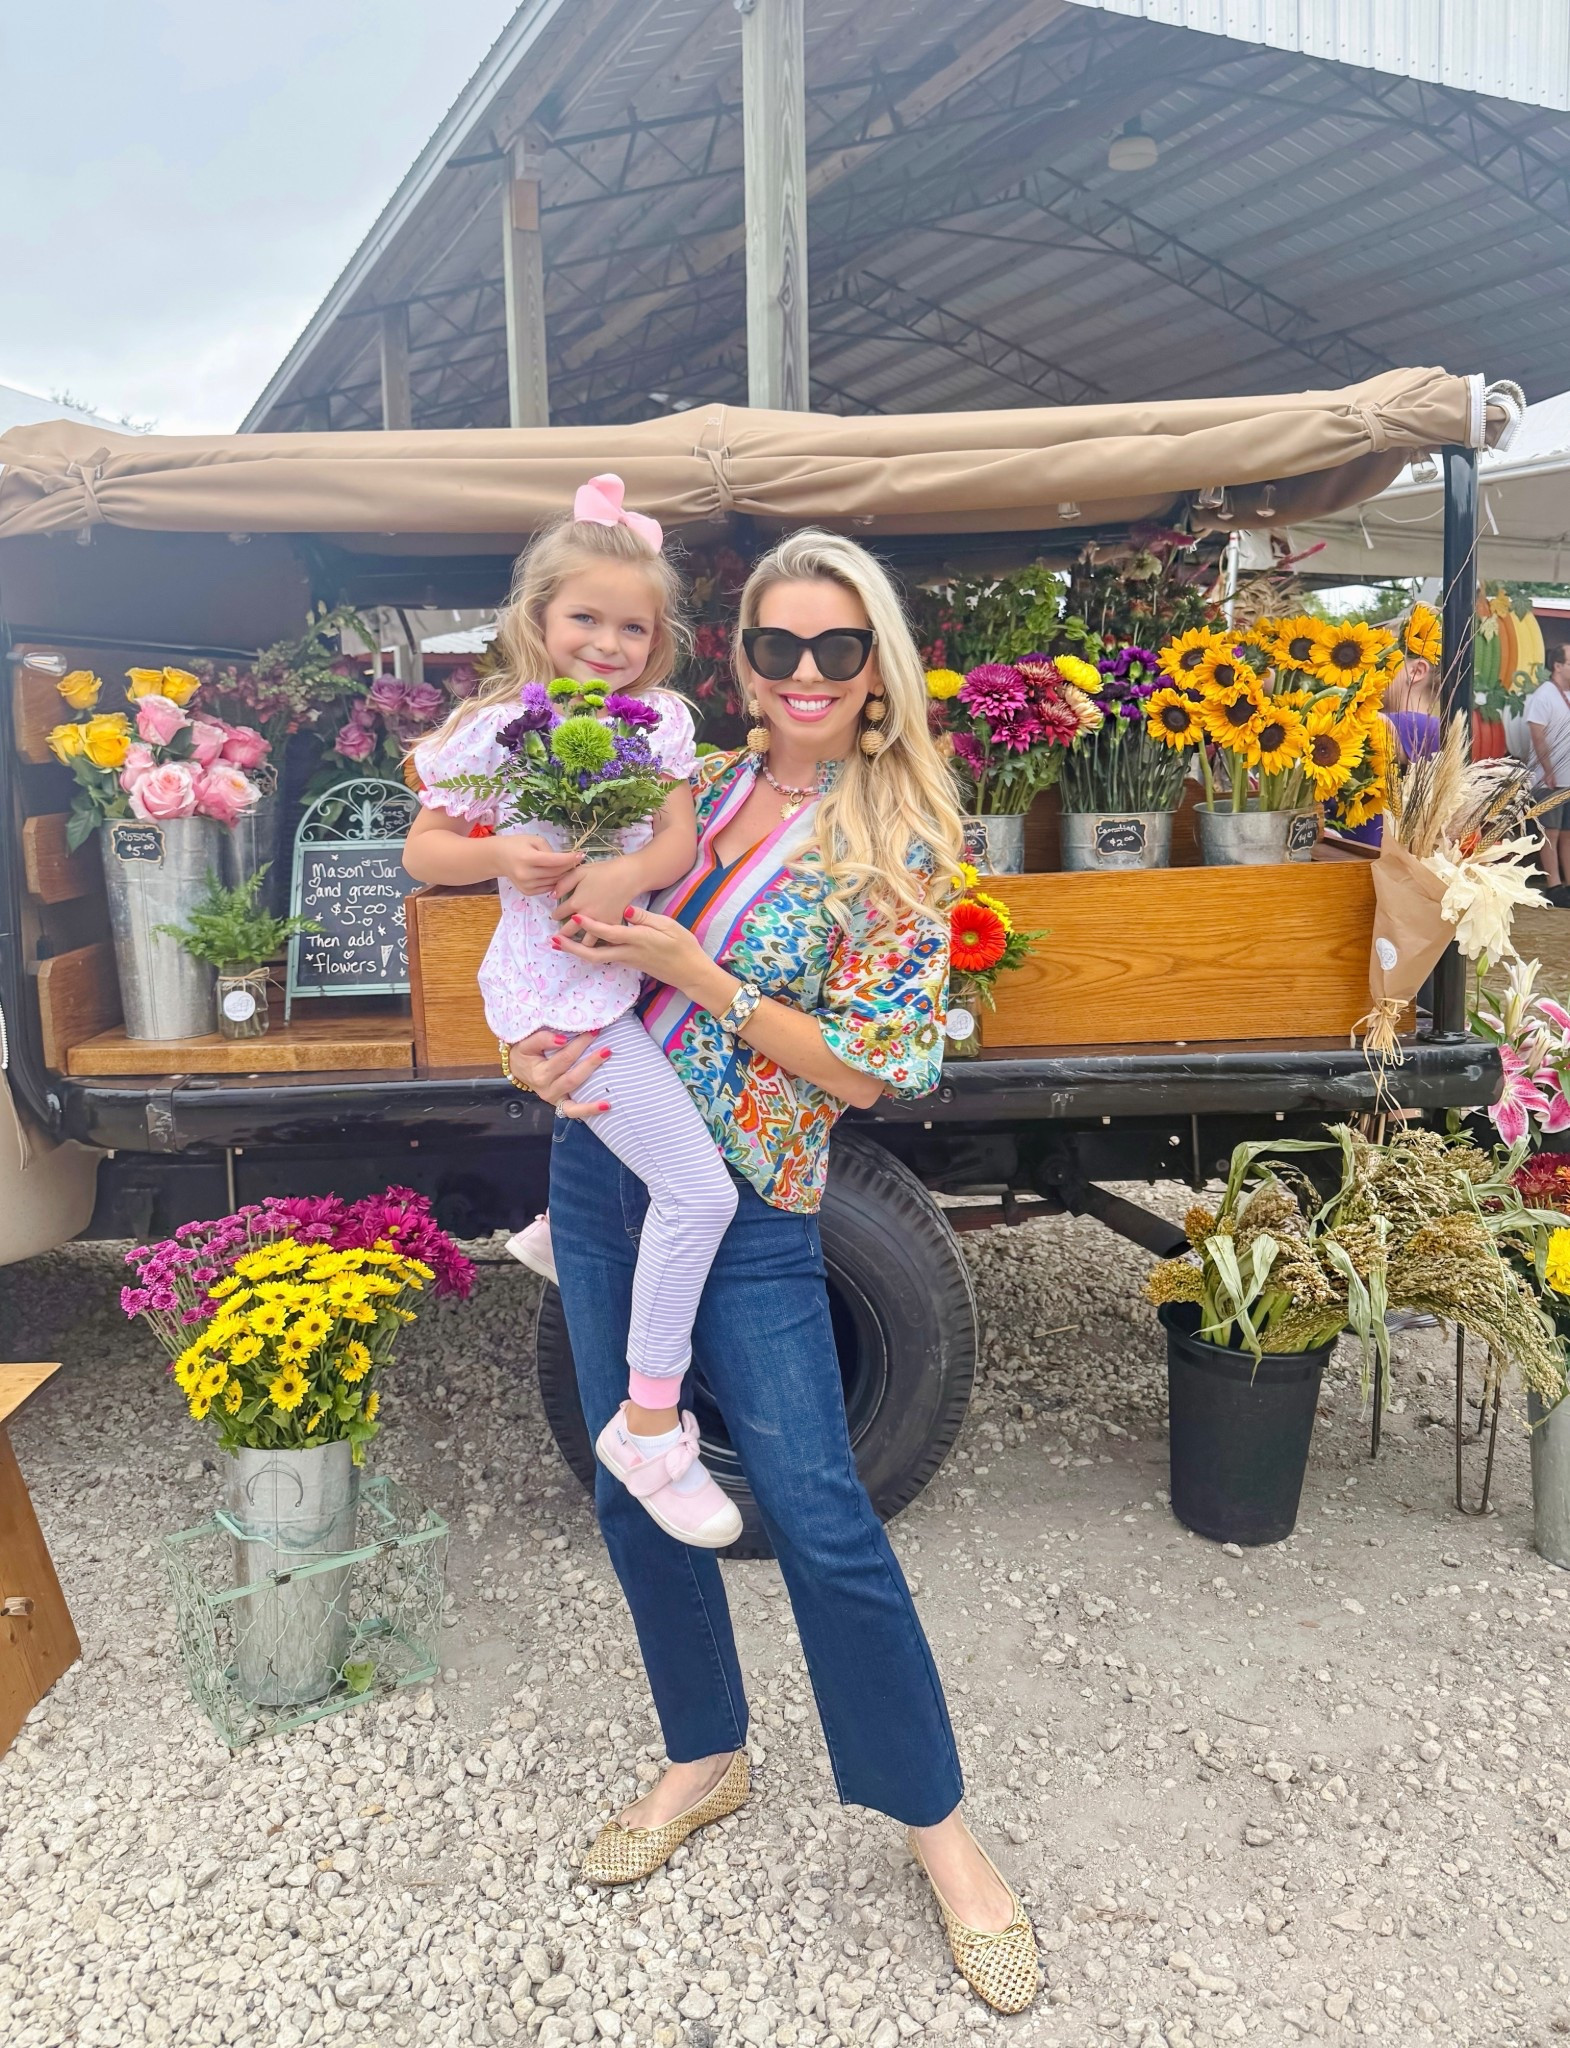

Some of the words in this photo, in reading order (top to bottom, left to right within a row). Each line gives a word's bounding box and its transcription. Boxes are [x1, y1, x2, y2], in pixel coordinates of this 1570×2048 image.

[126, 843, 155, 856] $5.00
[1109, 836, 1135, 847] $2.00
[312, 863, 364, 878] Mason
[371, 858, 402, 878] Jar
[316, 882, 341, 897] and
[346, 884, 394, 904] greens
[330, 902, 387, 925] $5.00
[306, 934, 340, 947] Then
[348, 930, 375, 946] add
